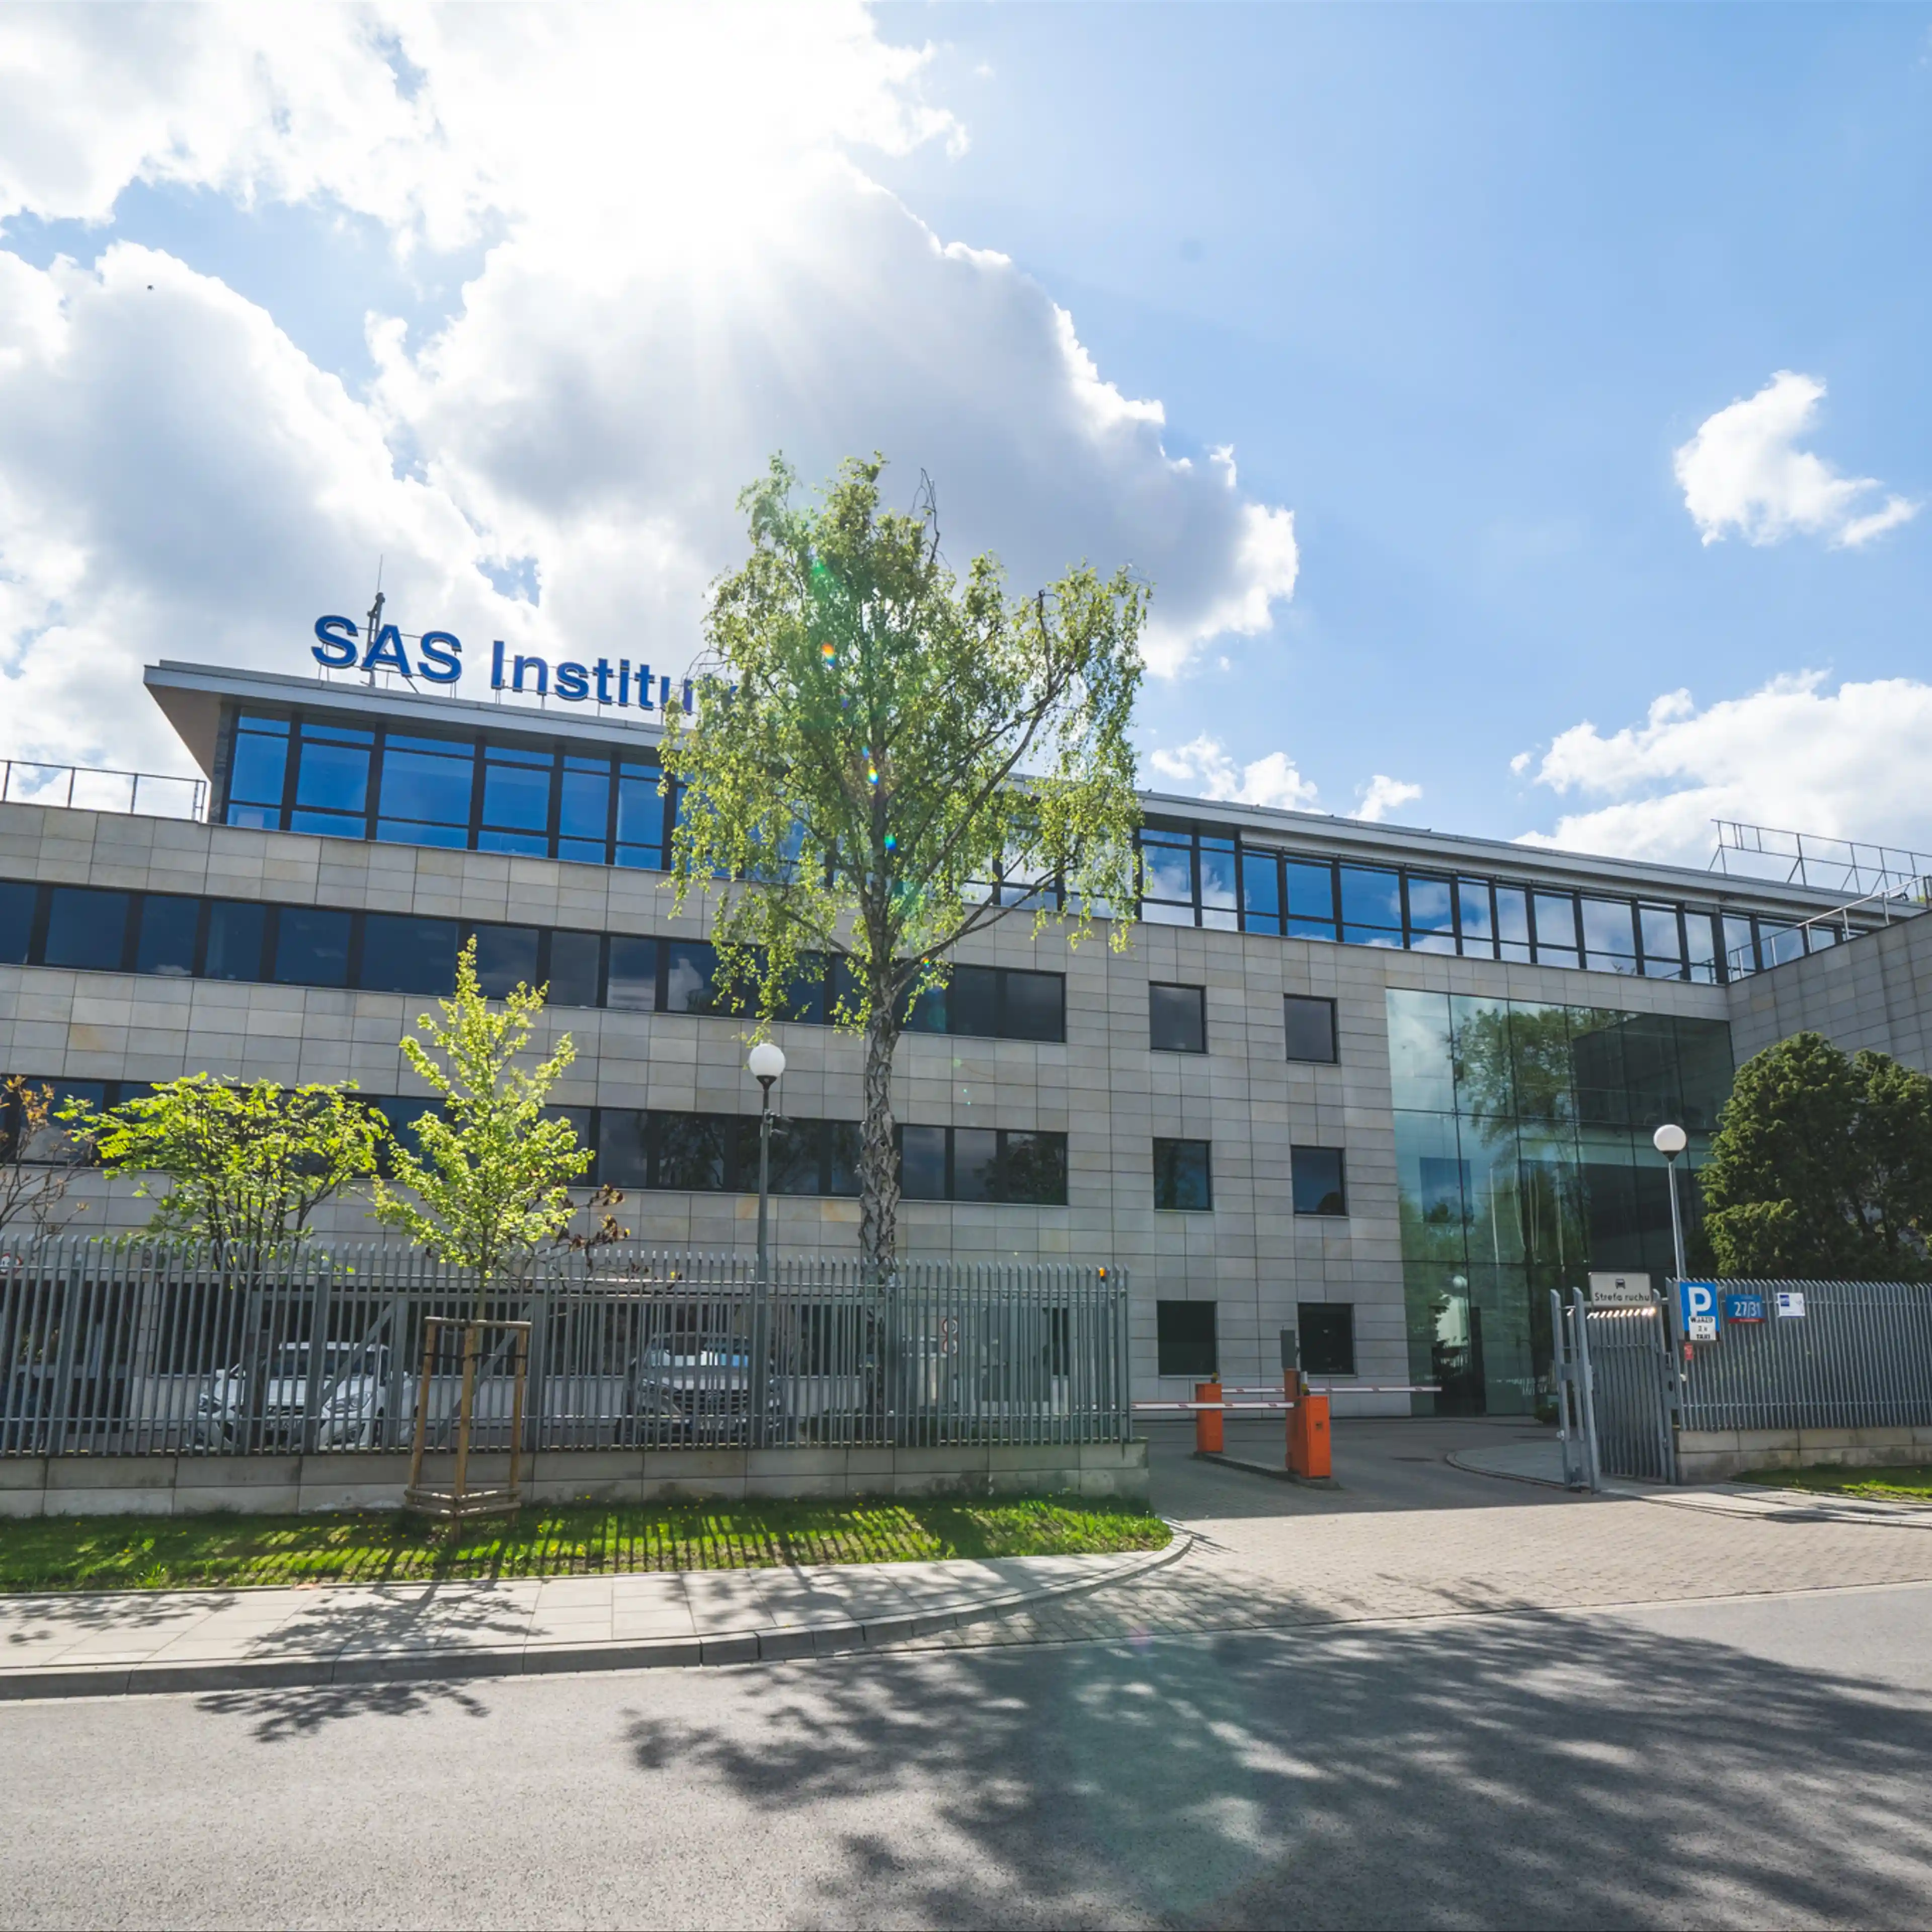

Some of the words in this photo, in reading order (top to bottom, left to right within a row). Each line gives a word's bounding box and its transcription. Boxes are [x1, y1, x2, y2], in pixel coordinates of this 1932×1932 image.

[310, 614, 462, 683] SAS
[491, 640, 740, 719] Institu
[1594, 1292, 1623, 1302] Strefa
[1625, 1292, 1650, 1302] ruchu
[1688, 1286, 1712, 1316] P
[1734, 1301, 1761, 1317] 27/31
